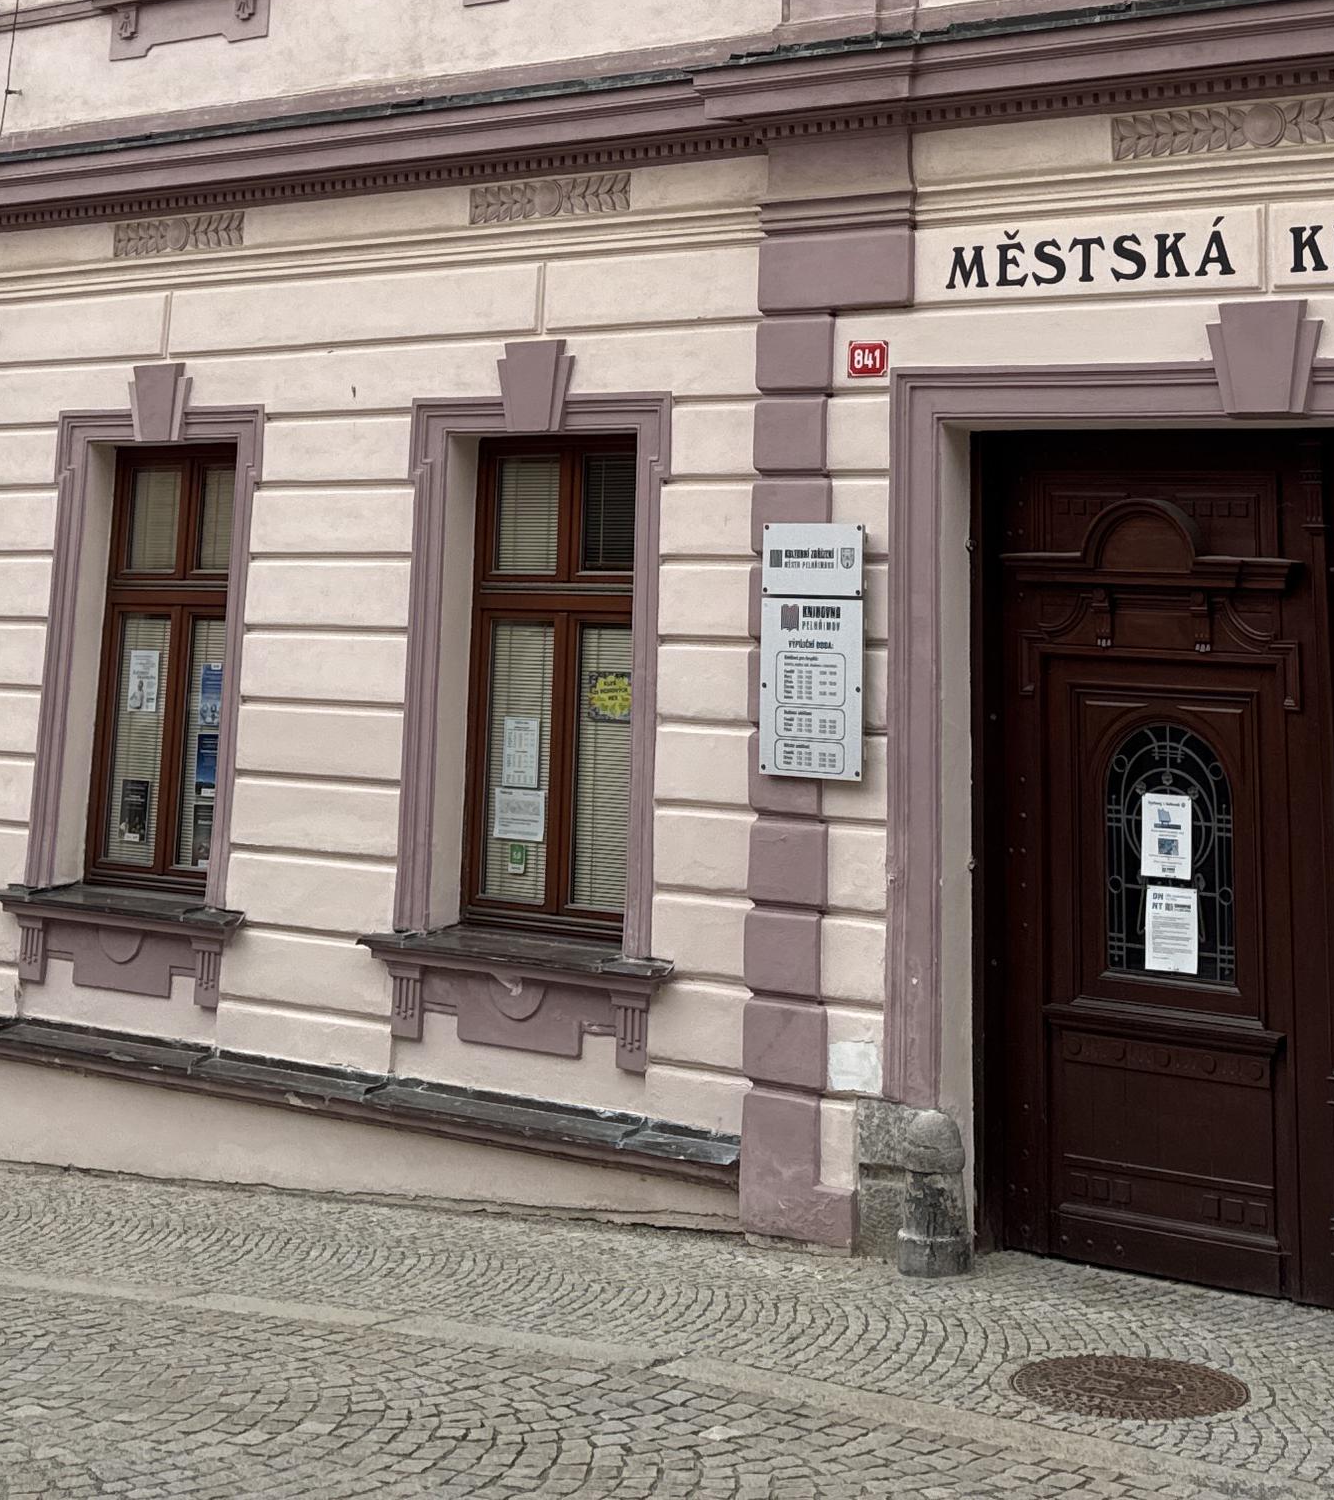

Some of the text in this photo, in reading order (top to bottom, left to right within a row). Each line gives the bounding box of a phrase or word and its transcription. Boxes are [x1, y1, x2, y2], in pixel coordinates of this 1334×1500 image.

[945, 217, 1236, 289] MĚSTSKÁ
[854, 349, 880, 368] 841
[802, 605, 840, 618] KNIHOVNA
[802, 619, 840, 631] PELHŘIMOV
